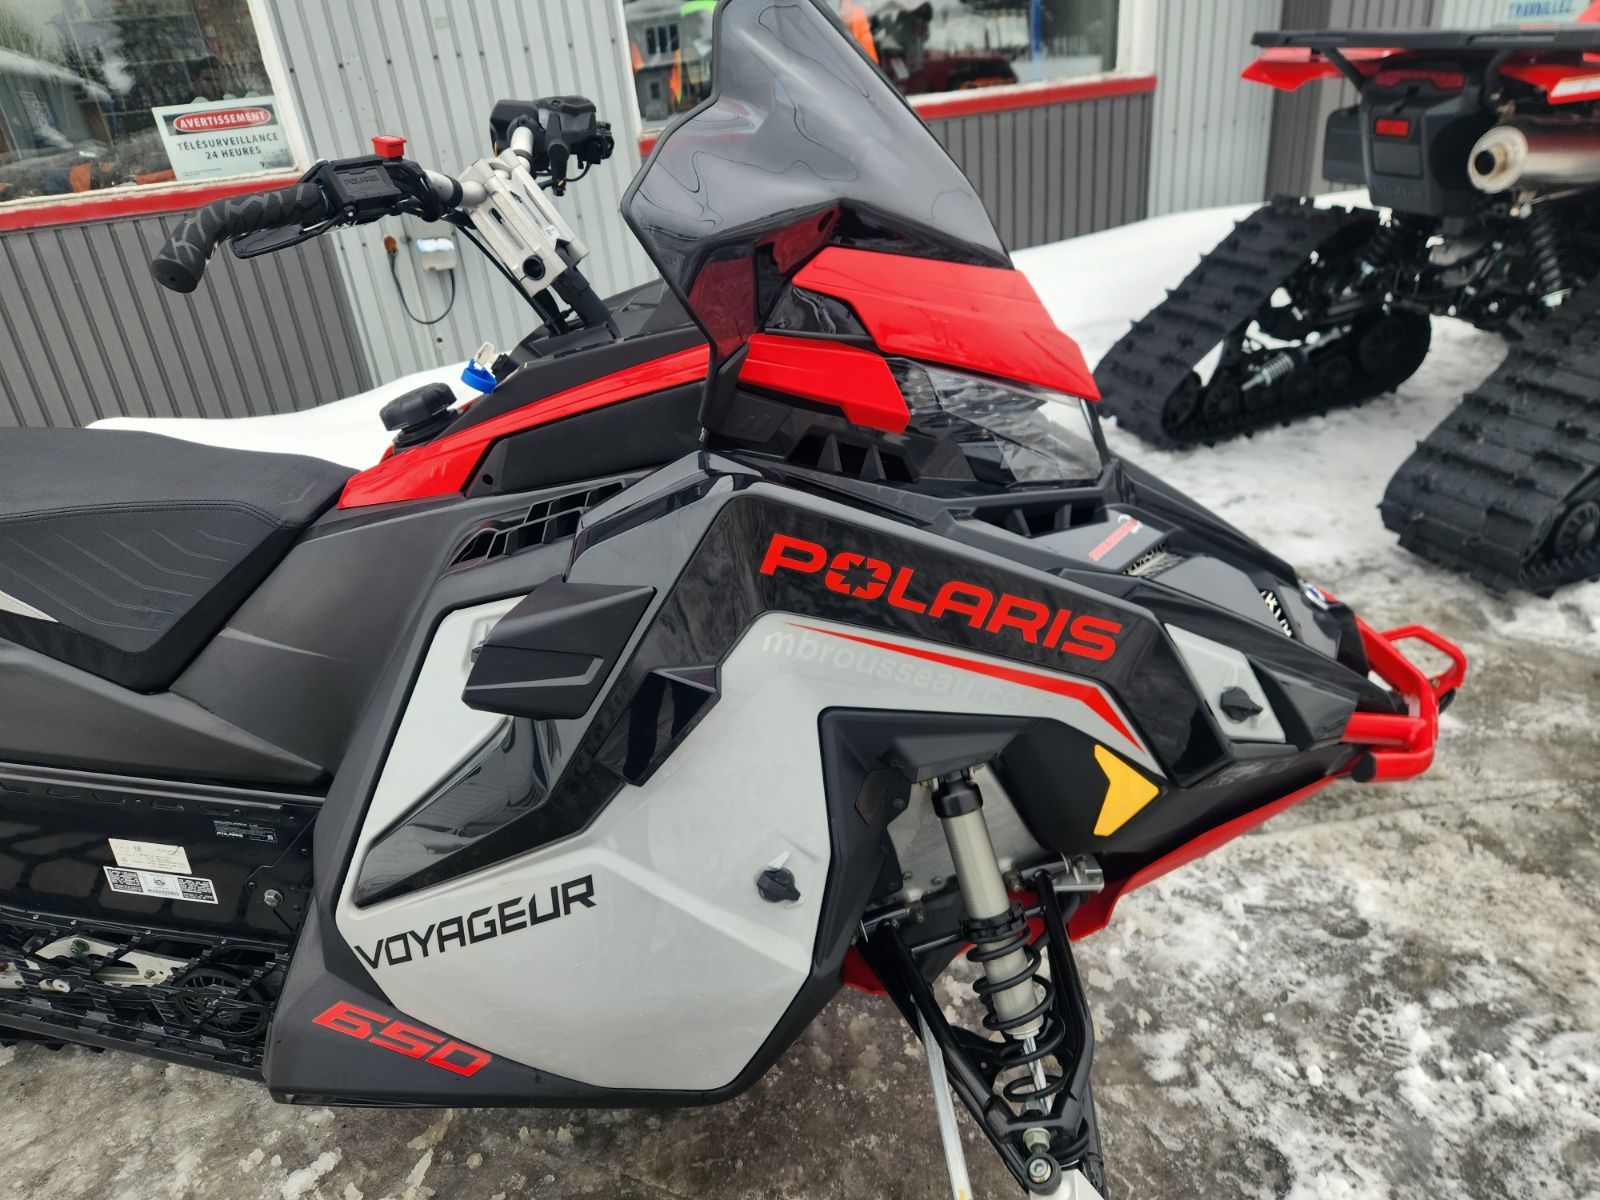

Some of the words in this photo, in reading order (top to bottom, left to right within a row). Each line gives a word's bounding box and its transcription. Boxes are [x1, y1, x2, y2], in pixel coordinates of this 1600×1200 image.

[180, 110, 266, 129] AVERTISSEMENT
[205, 151, 218, 160] 24
[222, 146, 262, 158] HEURES
[760, 533, 1122, 661] POLARIS
[354, 874, 597, 969] VOYAGEUR
[312, 1000, 492, 1077] 650
